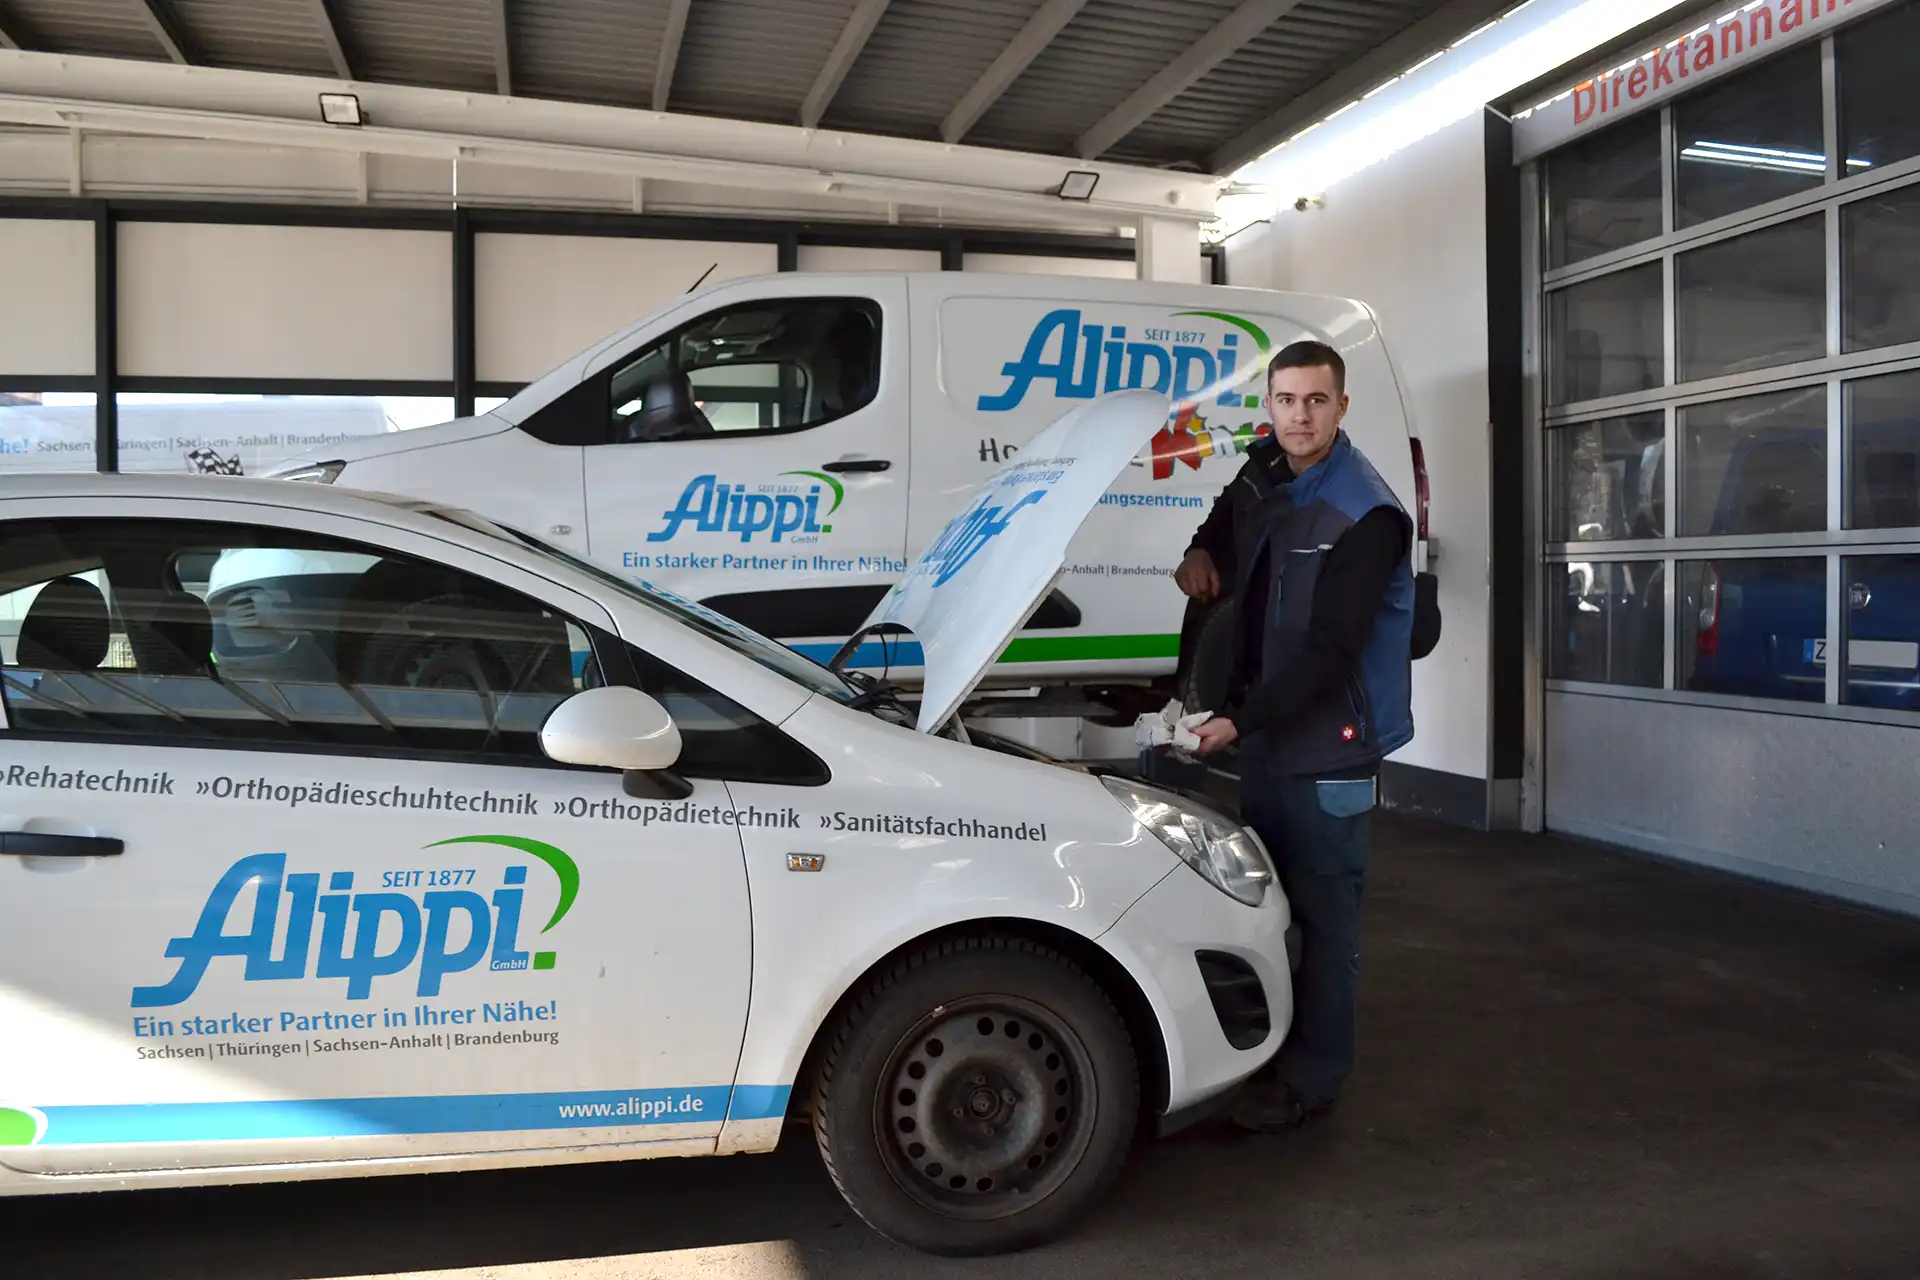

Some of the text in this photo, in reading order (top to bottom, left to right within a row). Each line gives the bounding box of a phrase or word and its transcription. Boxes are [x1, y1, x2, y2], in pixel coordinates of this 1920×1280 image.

[1574, 0, 1854, 125] Direktanna
[1145, 328, 1206, 344] SEIT 1877
[0, 437, 28, 454] he!
[37, 440, 91, 453] Sachsen
[116, 438, 167, 451] üringen
[1098, 493, 1203, 508] ungszentrum
[623, 552, 650, 568] Ein
[655, 553, 718, 569] starker
[722, 554, 788, 570] Partner
[792, 555, 808, 570] in
[813, 556, 855, 571] Ihrer
[859, 556, 908, 573] Nähe!
[1111, 564, 1175, 578] Brandenburg
[382, 869, 477, 888] SEIT 1877
[491, 959, 527, 970] GmbH
[133, 1000, 557, 1038] Ein starker Partner in Ihrer Nähe!
[137, 1029, 560, 1060] Sachsen Thüringen Sachsen-Anhalt Brandenburg
[558, 1094, 703, 1119] www.alippi.de
